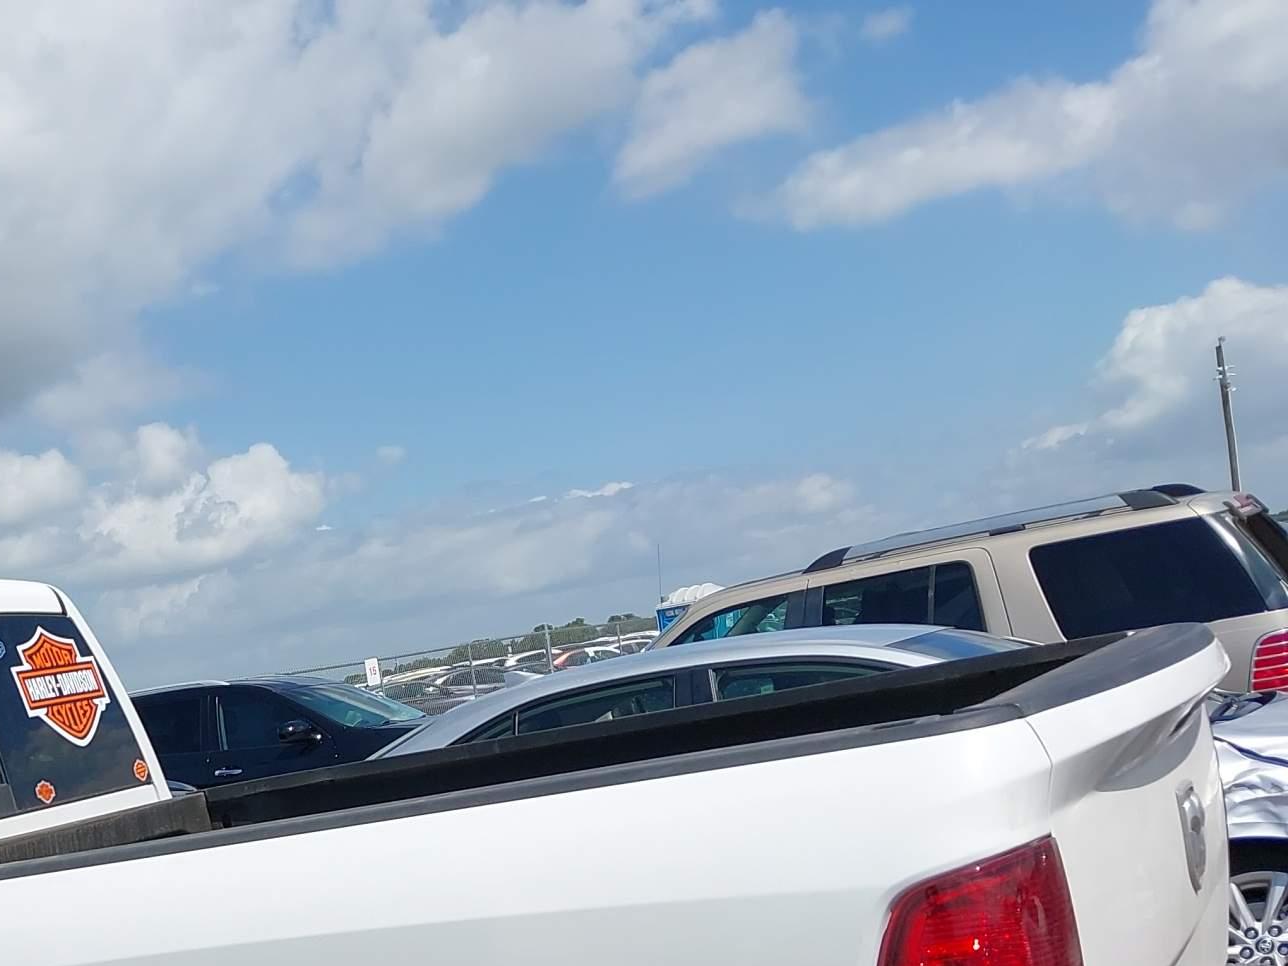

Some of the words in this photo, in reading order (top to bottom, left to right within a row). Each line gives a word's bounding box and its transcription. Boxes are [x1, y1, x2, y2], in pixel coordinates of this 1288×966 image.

[32, 642, 73, 669] MOTOR
[24, 669, 99, 702] HARLEY-DAVIDSON
[52, 700, 91, 731] CYCLES
